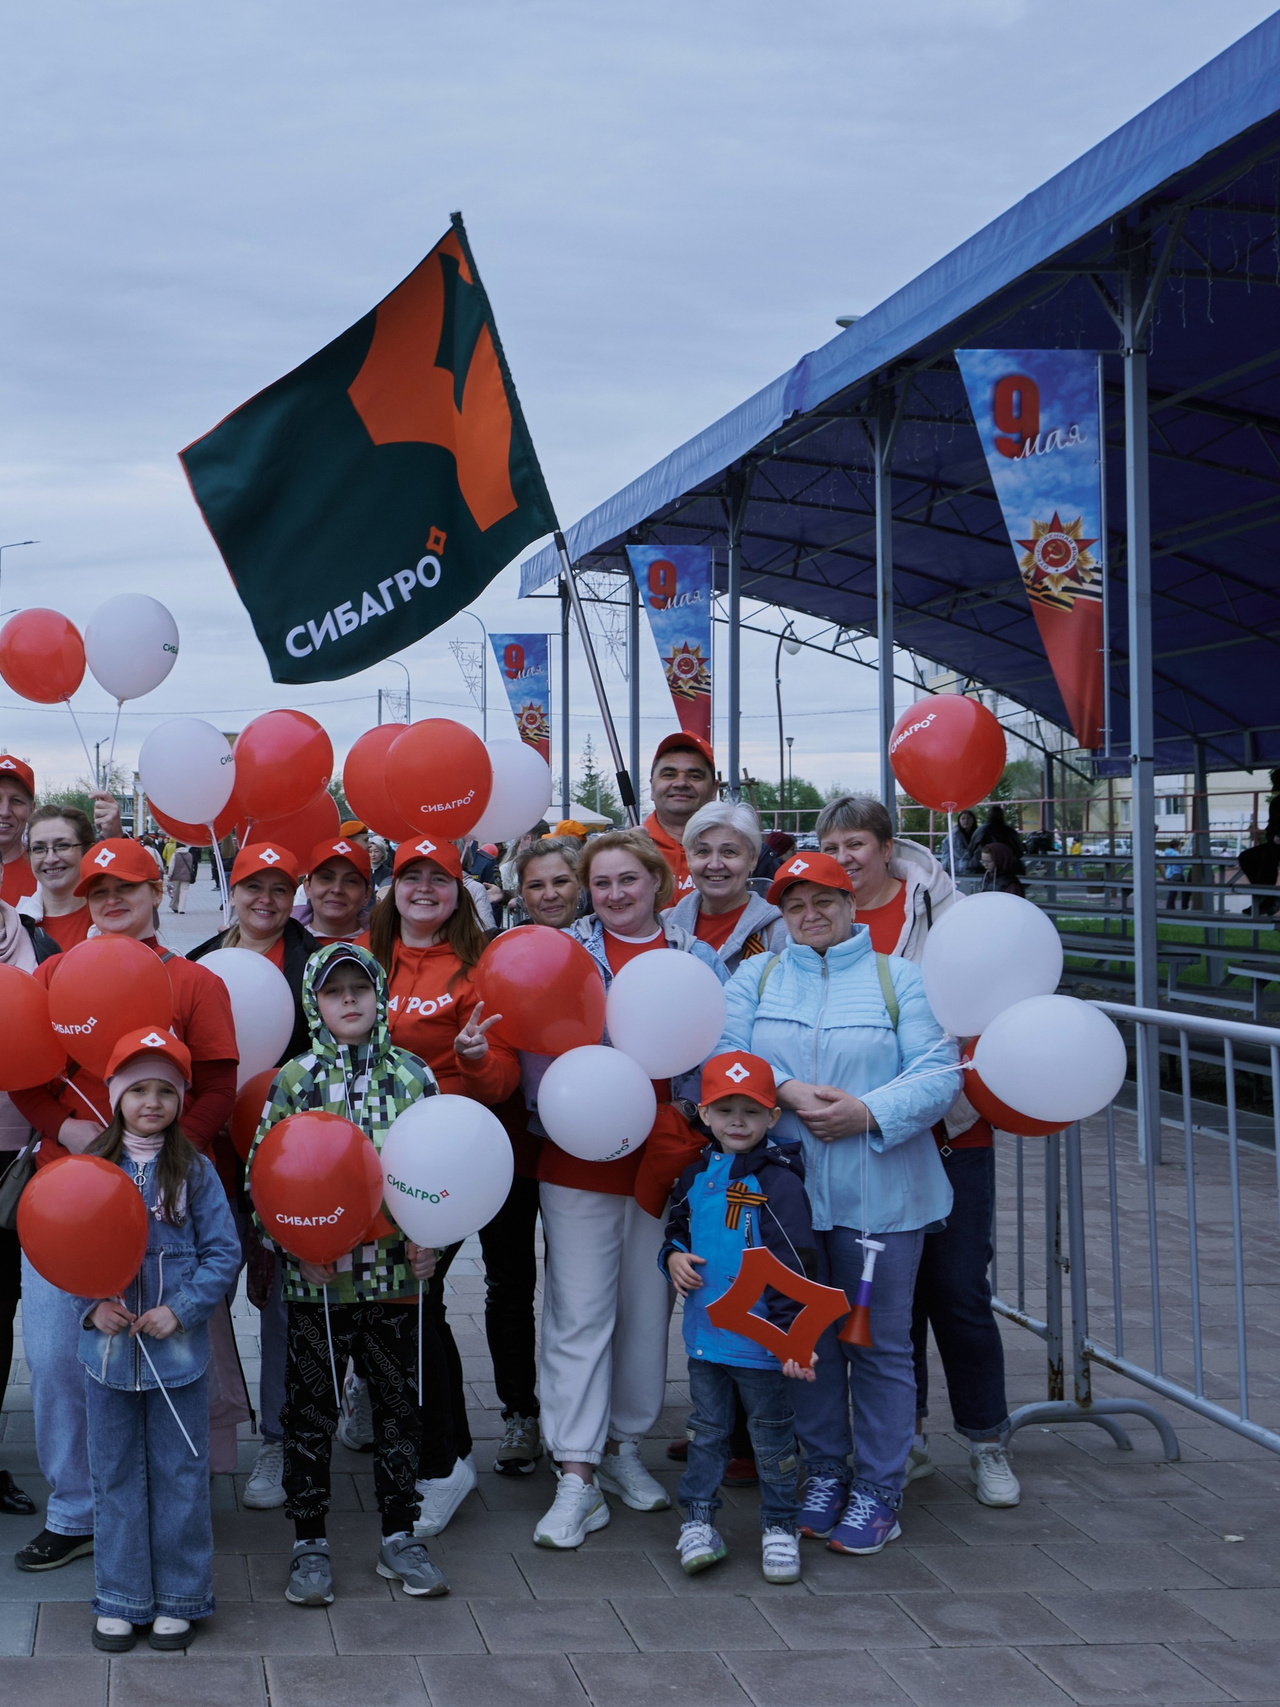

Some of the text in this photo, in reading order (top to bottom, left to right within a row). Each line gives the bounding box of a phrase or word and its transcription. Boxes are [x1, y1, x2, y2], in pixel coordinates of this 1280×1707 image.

[994, 374, 1088, 461] 9 мая
[648, 560, 707, 612] 9 мая
[285, 555, 441, 658] СИБАГРО
[504, 643, 525, 680] 9
[420, 796, 471, 813] СИБАГРО
[386, 1173, 441, 1204] СИБАГРО
[275, 1213, 338, 1227] СИБАГРО
